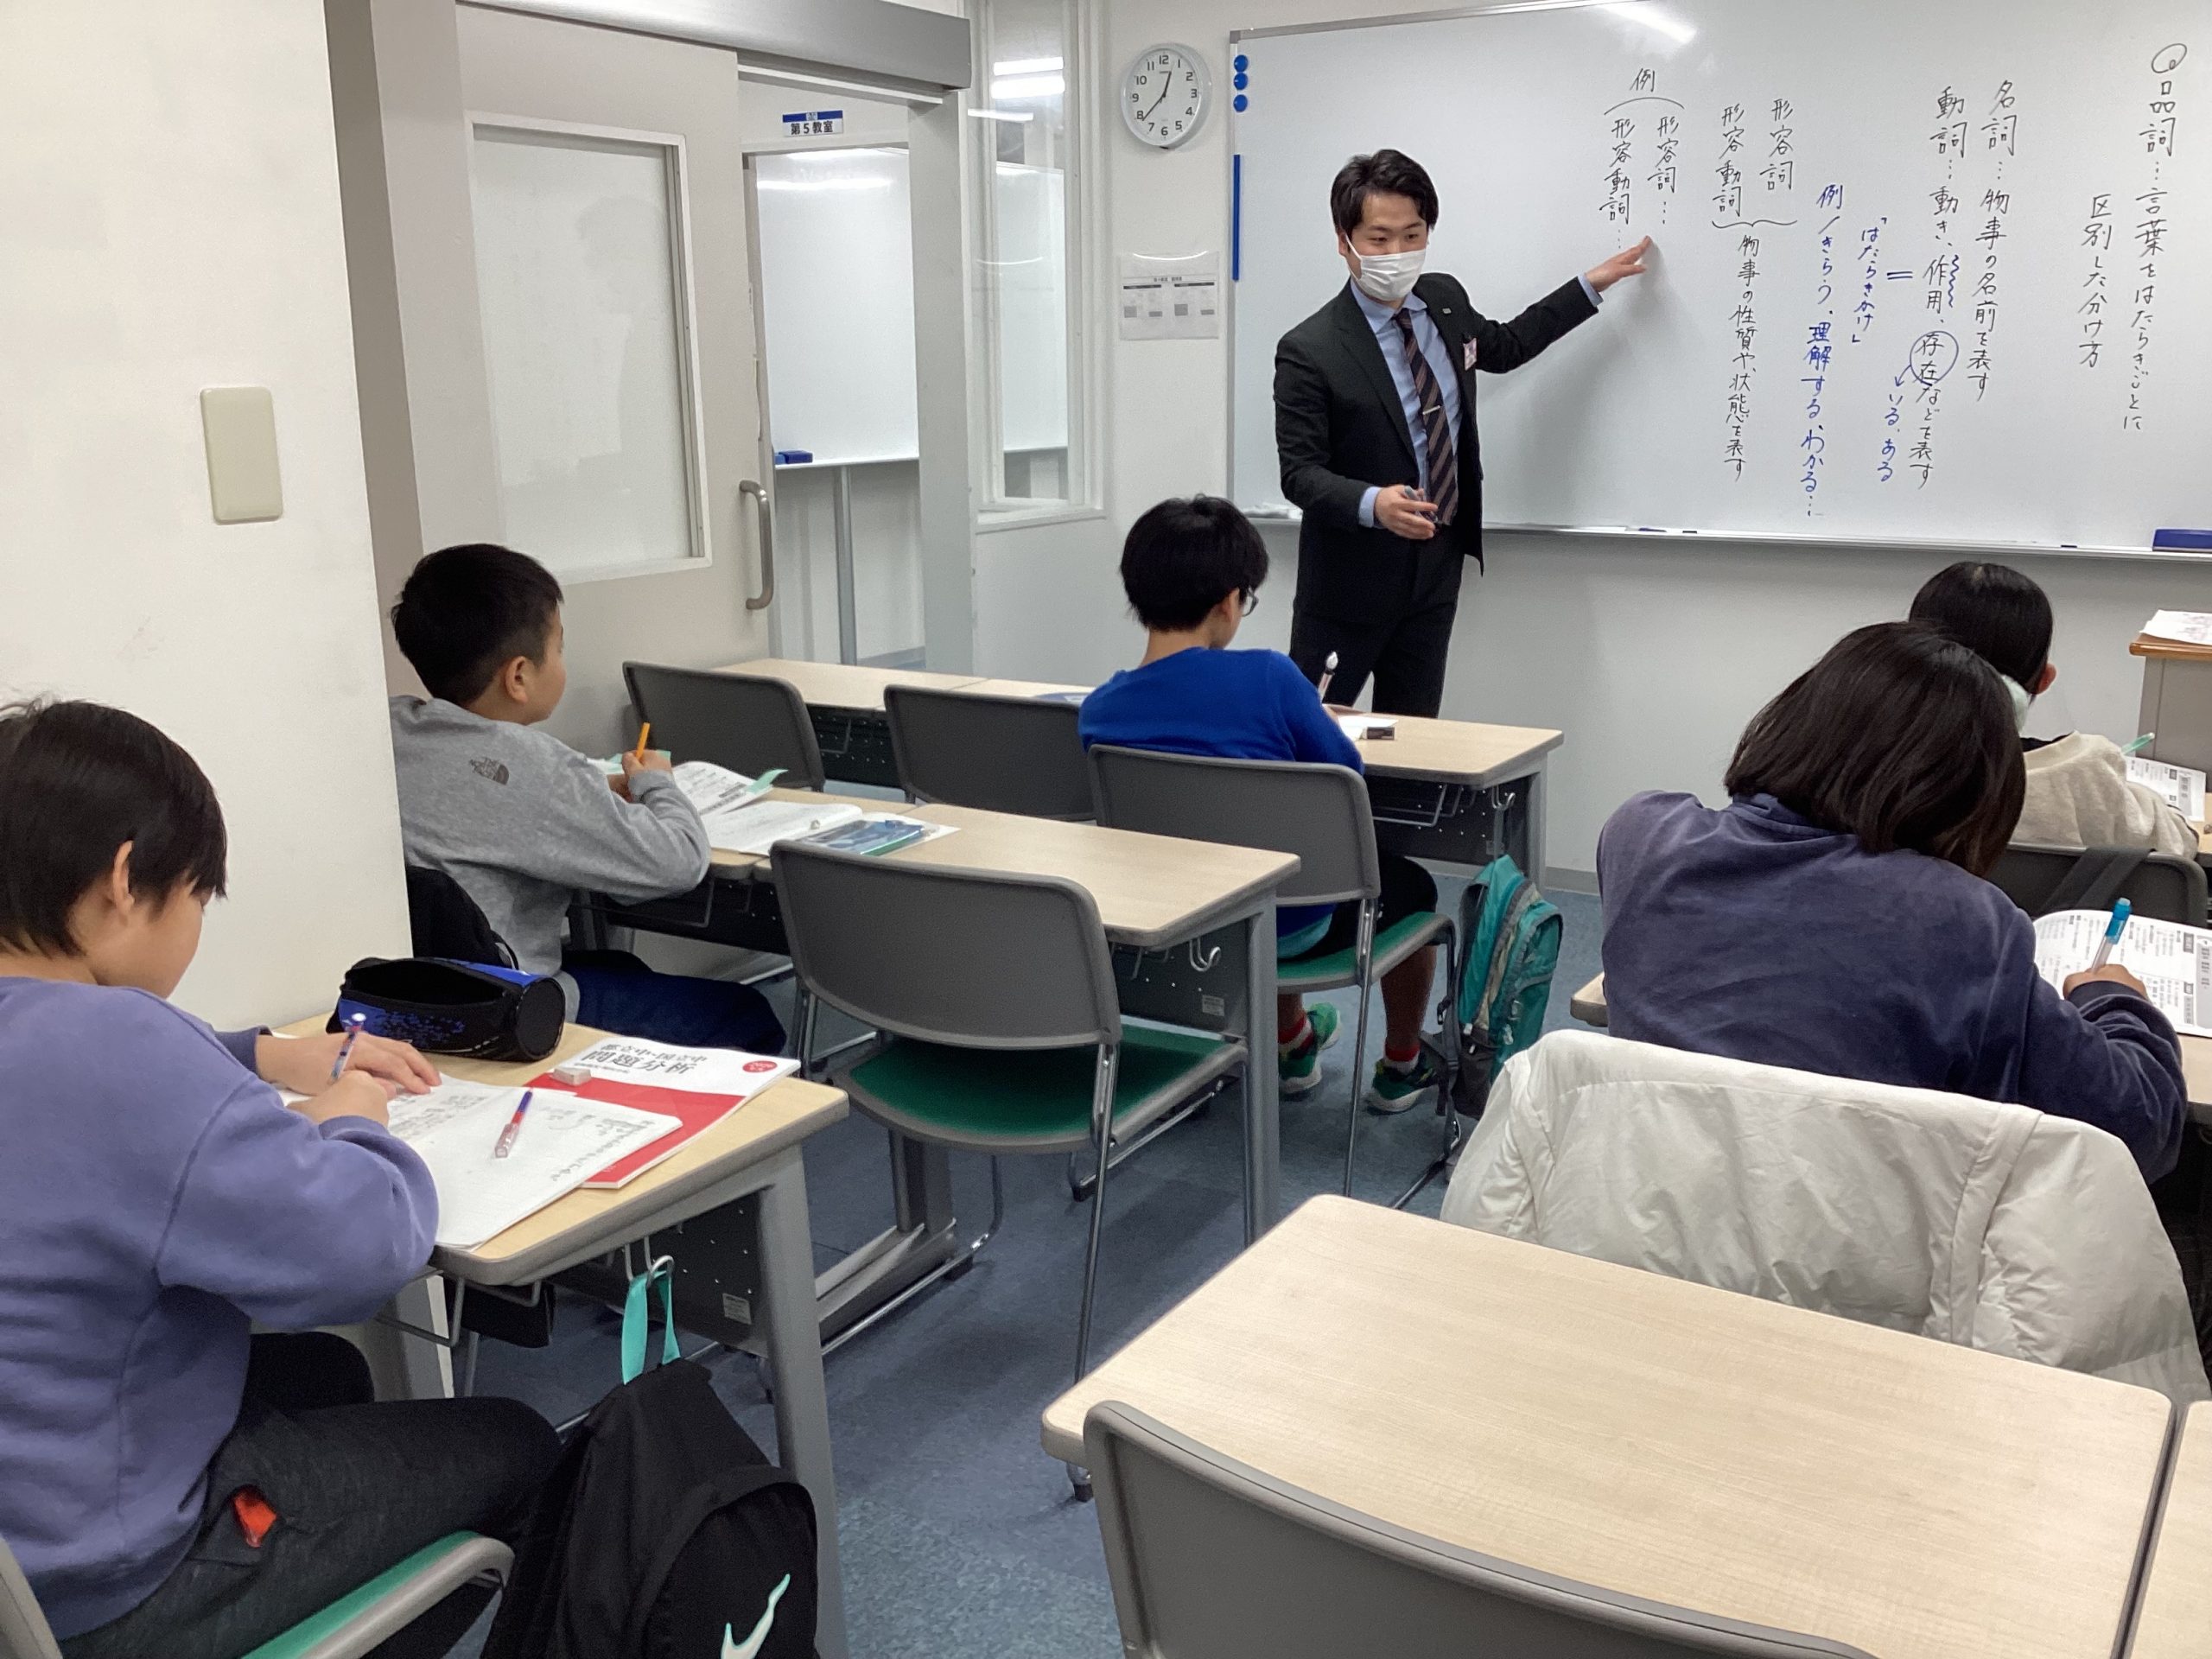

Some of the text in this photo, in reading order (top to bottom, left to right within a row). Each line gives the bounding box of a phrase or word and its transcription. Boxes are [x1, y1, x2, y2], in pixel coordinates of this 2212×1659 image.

[1159, 54, 1169, 65] 12
[1147, 61, 1154, 71] 11
[1135, 75, 1147, 85] 10
[1185, 72, 1193, 81] 2
[1629, 67, 1656, 92] 例
[1132, 93, 1139, 102] 9
[1191, 88, 1198, 98] 3
[1136, 111, 1144, 120] 8
[1185, 106, 1192, 116] 4
[791, 120, 834, 135] 第5教室
[1148, 122, 1155, 132] 7
[1175, 120, 1183, 130] 5
[1160, 126, 1168, 136] 6
[1759, 98, 1794, 191] 形容詞
[1712, 103, 1745, 218] 形容動詞
[2077, 194, 2113, 368] 区別した分け方
